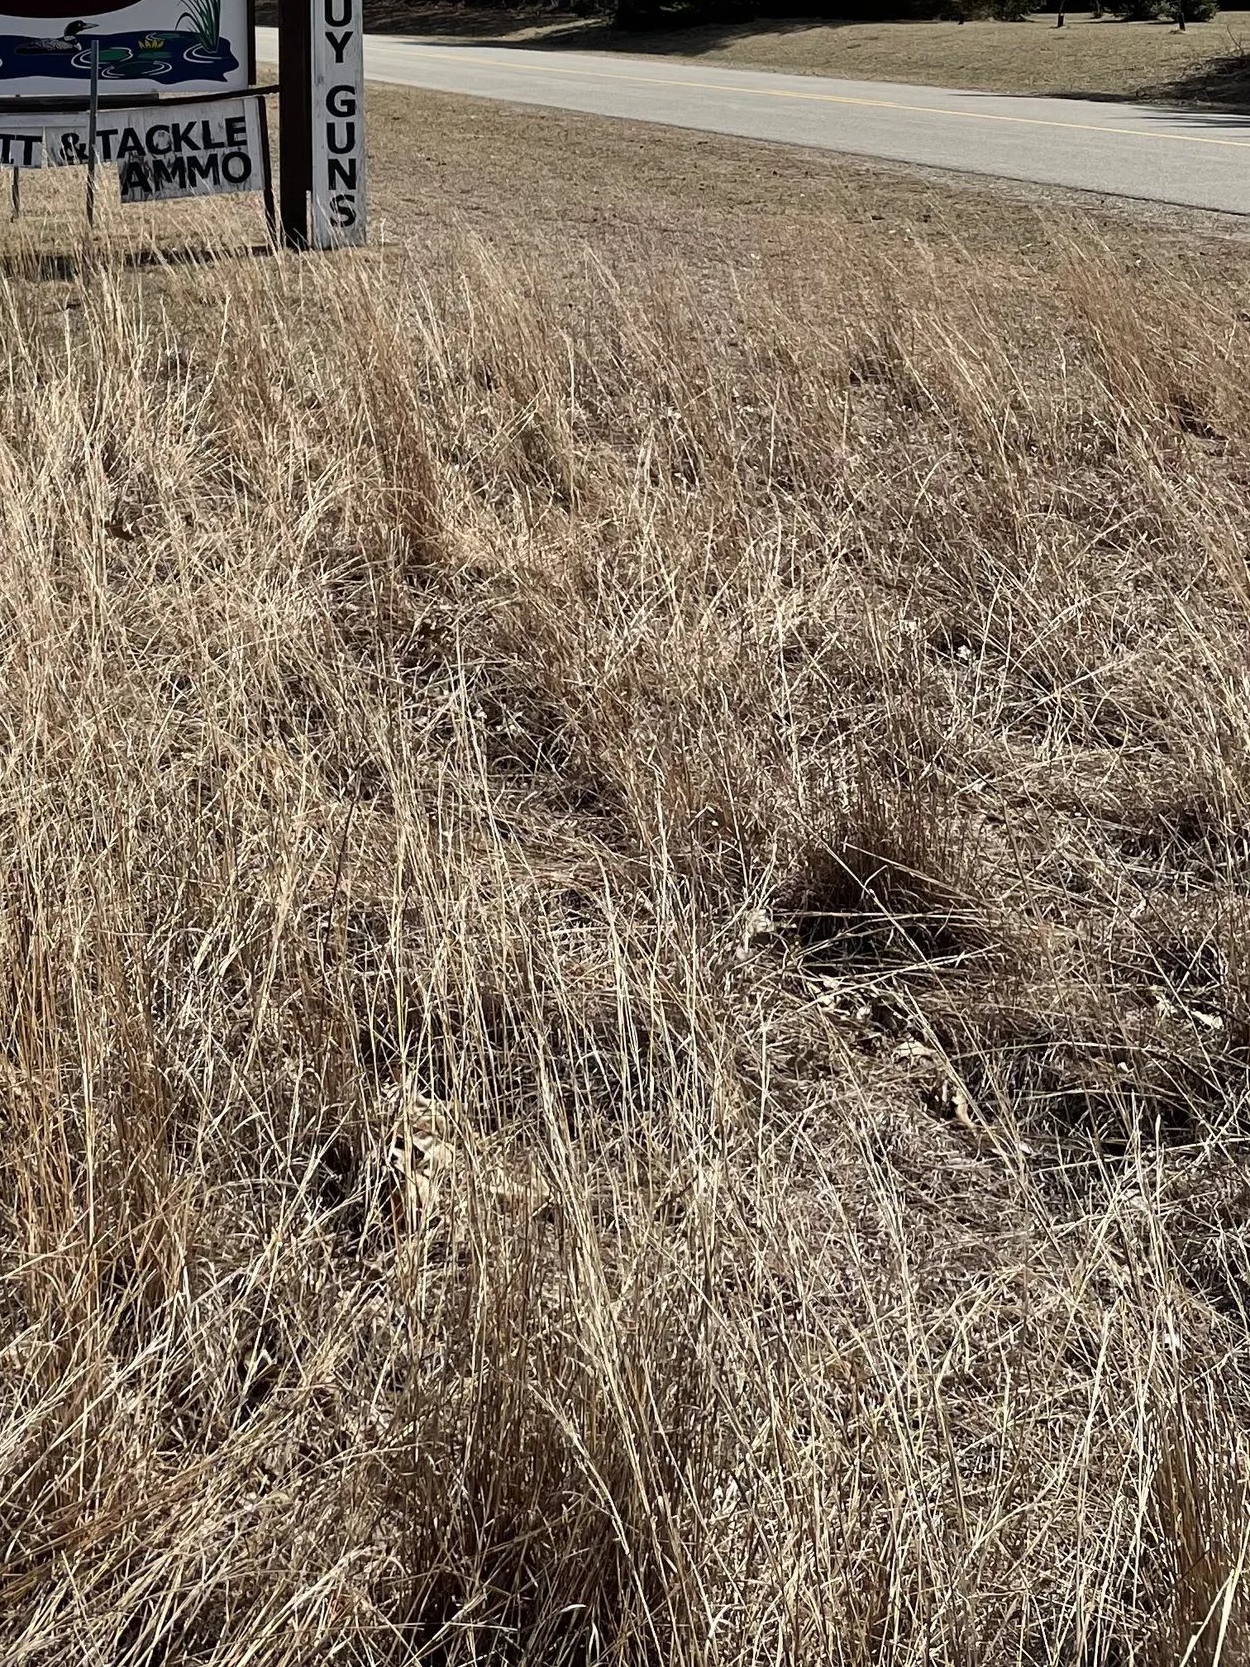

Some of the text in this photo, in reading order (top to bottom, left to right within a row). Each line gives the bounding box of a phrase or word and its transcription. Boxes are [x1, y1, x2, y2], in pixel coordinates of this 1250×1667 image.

[59, 133, 88, 162] &
[95, 115, 249, 159] TACKLE
[325, 84, 357, 228] GUNS
[120, 150, 252, 203] AMMO
